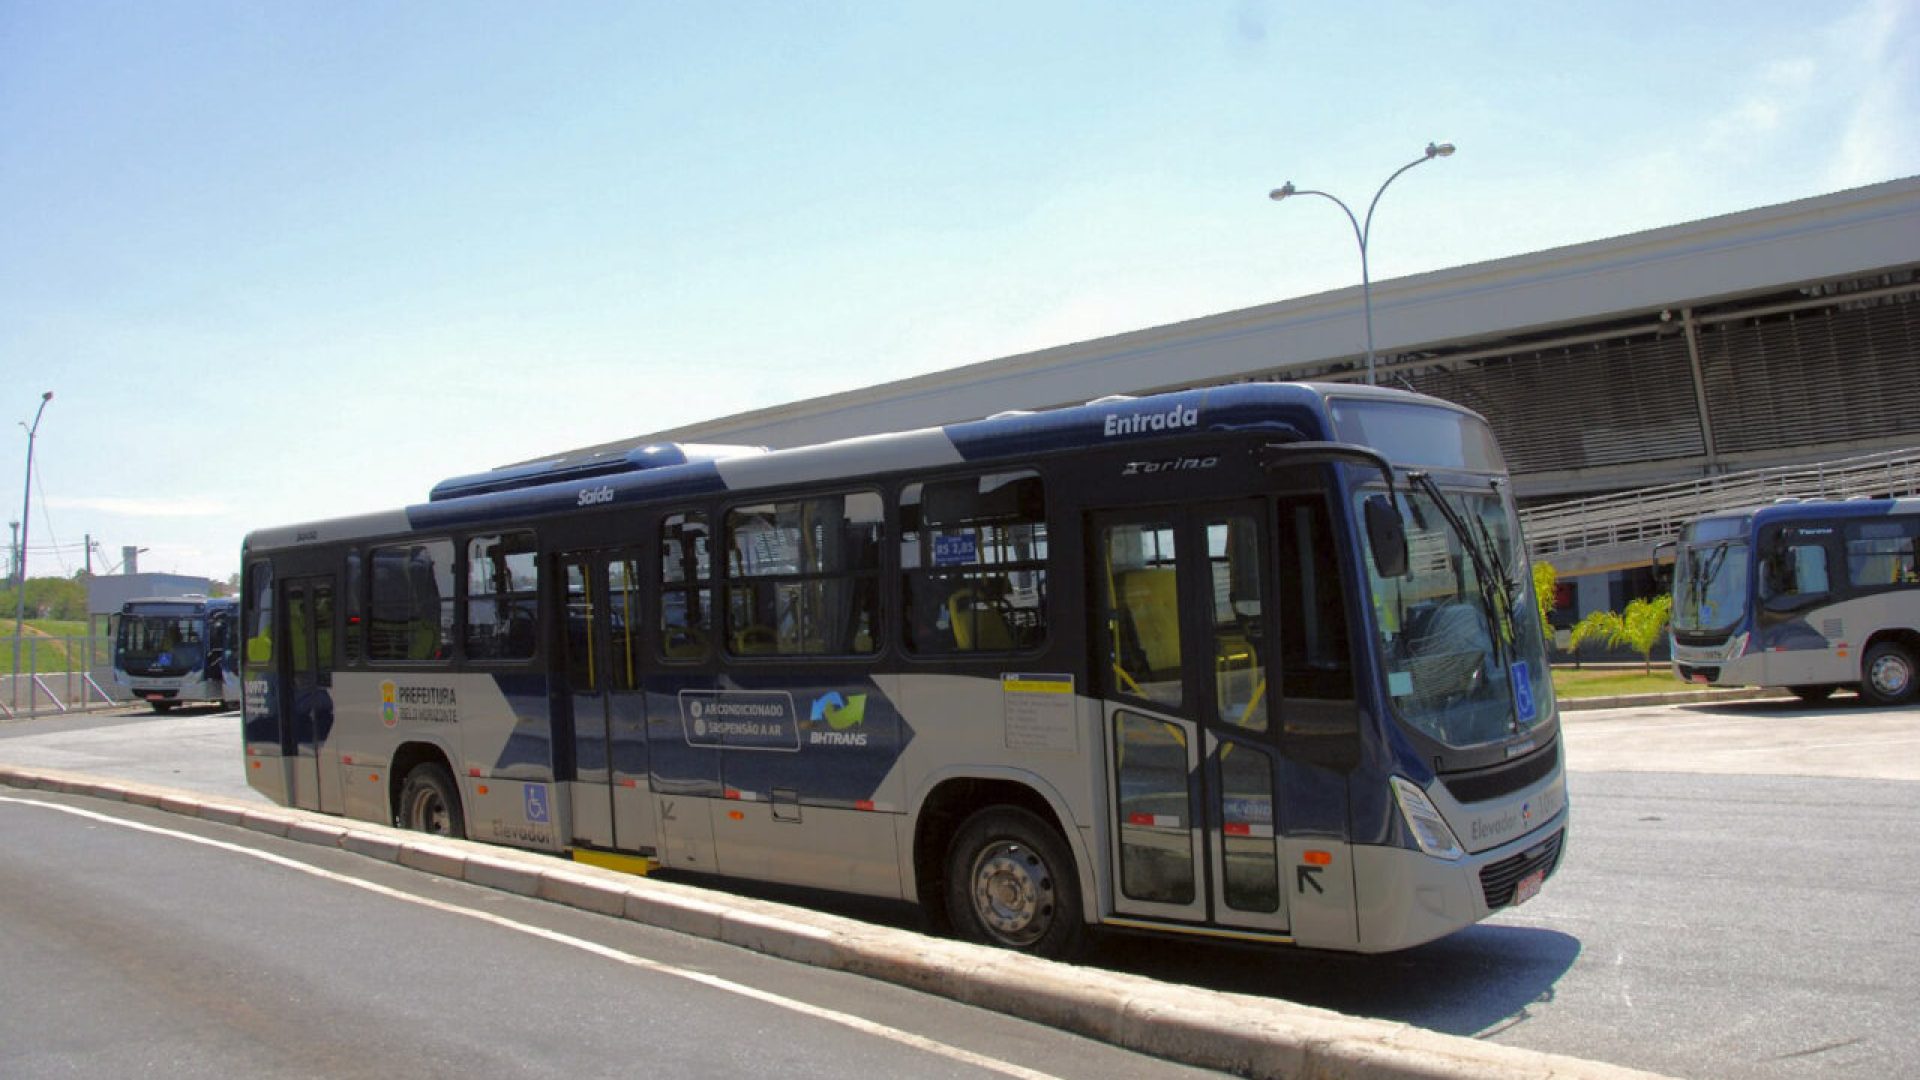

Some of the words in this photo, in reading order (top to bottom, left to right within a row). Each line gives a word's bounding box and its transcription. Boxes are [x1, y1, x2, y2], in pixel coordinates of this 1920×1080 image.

[1103, 404, 1199, 437] Entrada
[1121, 455, 1221, 477] Torino
[399, 686, 457, 706] PREFEITURA
[718, 704, 784, 718] CONDICIONADO
[810, 731, 868, 747] BHTRANS
